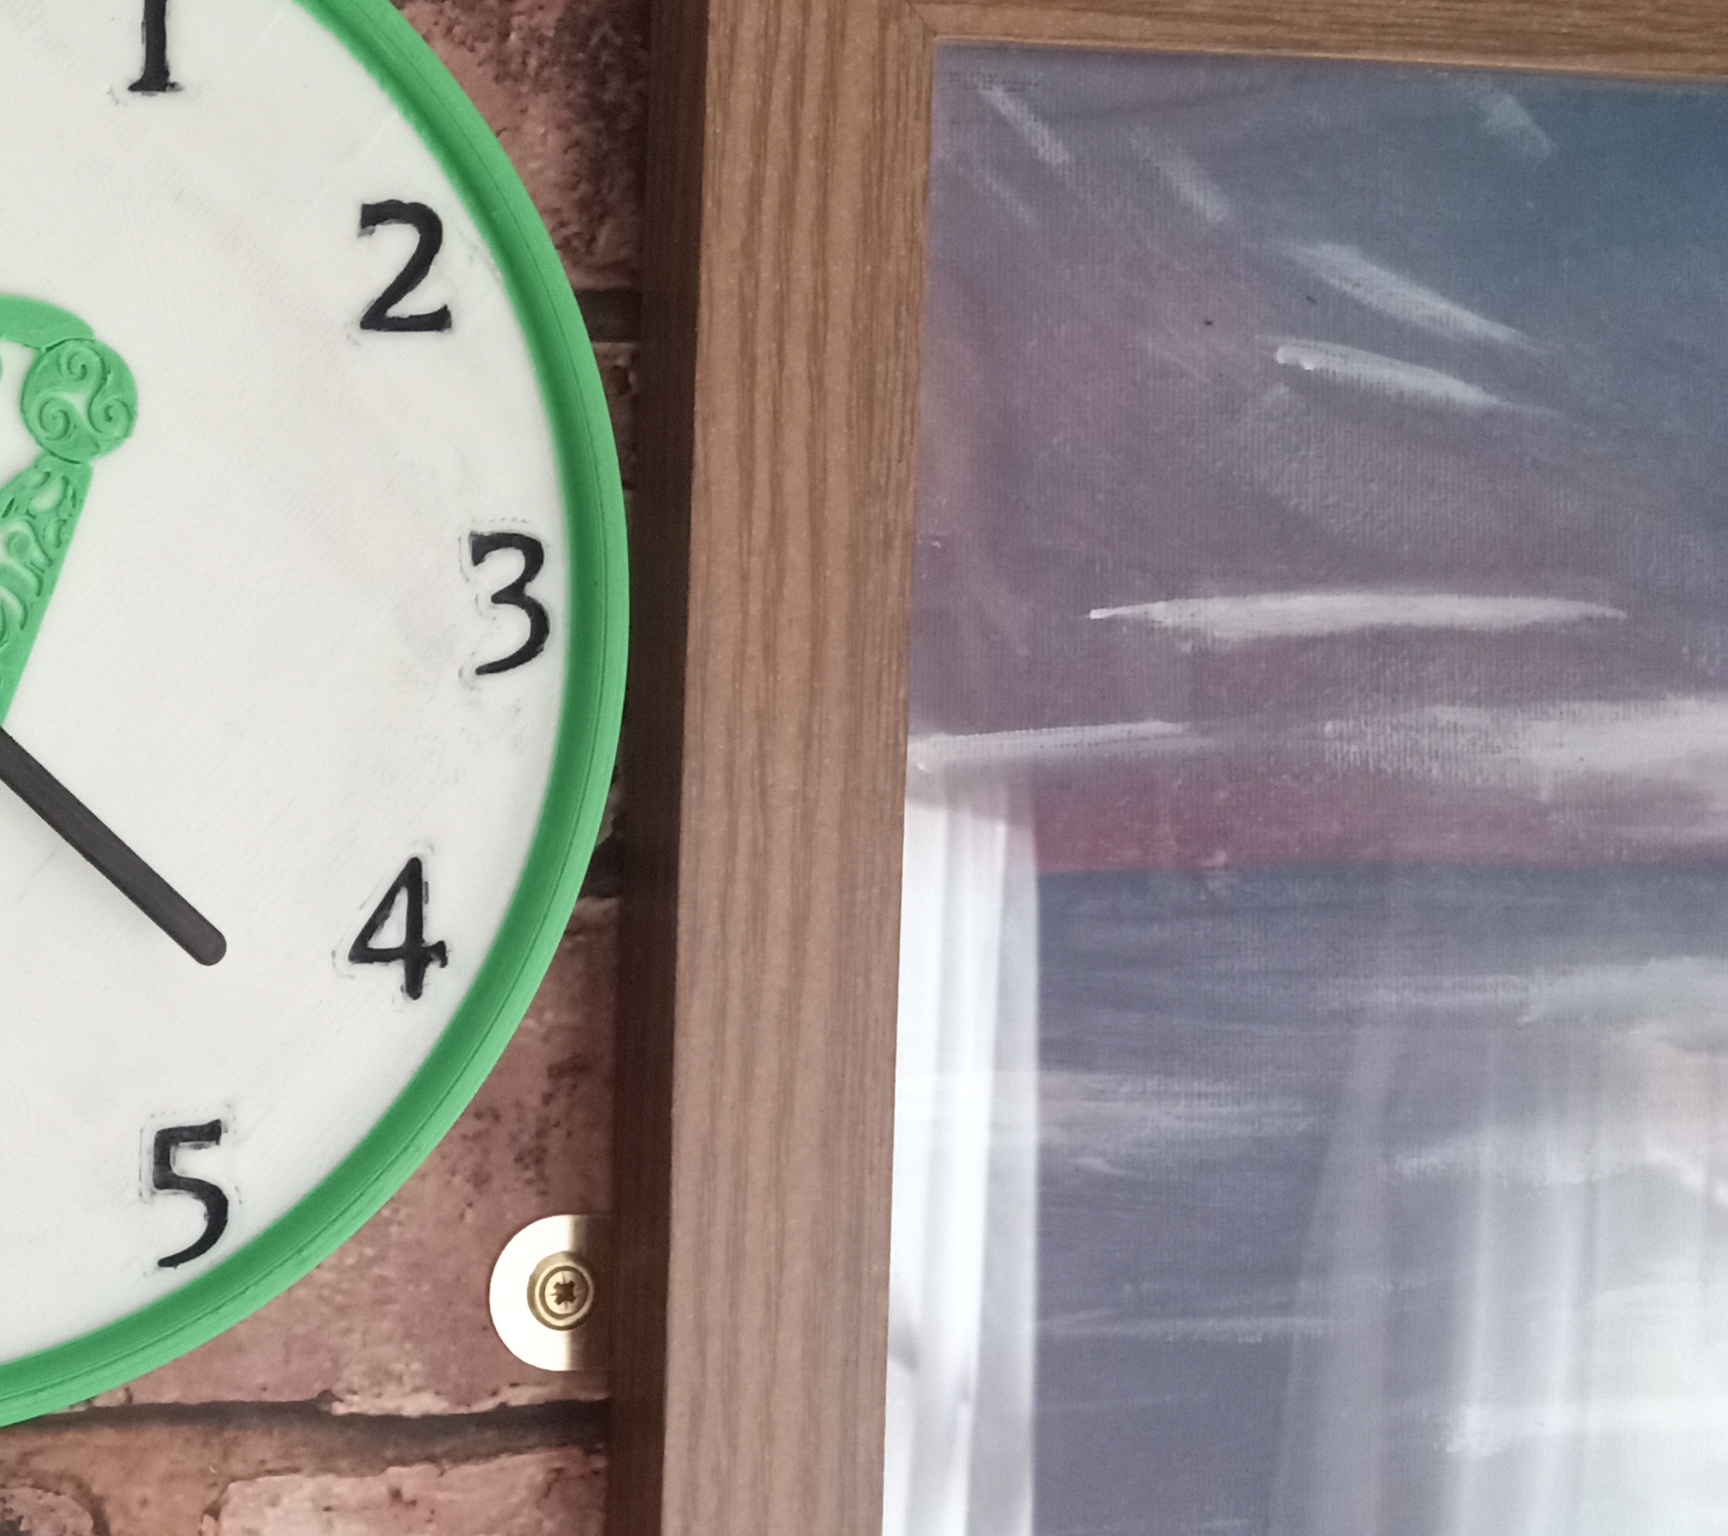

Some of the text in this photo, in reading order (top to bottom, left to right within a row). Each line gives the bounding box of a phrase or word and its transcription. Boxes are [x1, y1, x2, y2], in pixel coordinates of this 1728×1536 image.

[358, 198, 454, 334] 2
[468, 531, 551, 677] 3
[347, 855, 450, 1002] 4
[151, 1118, 230, 1270] 5
